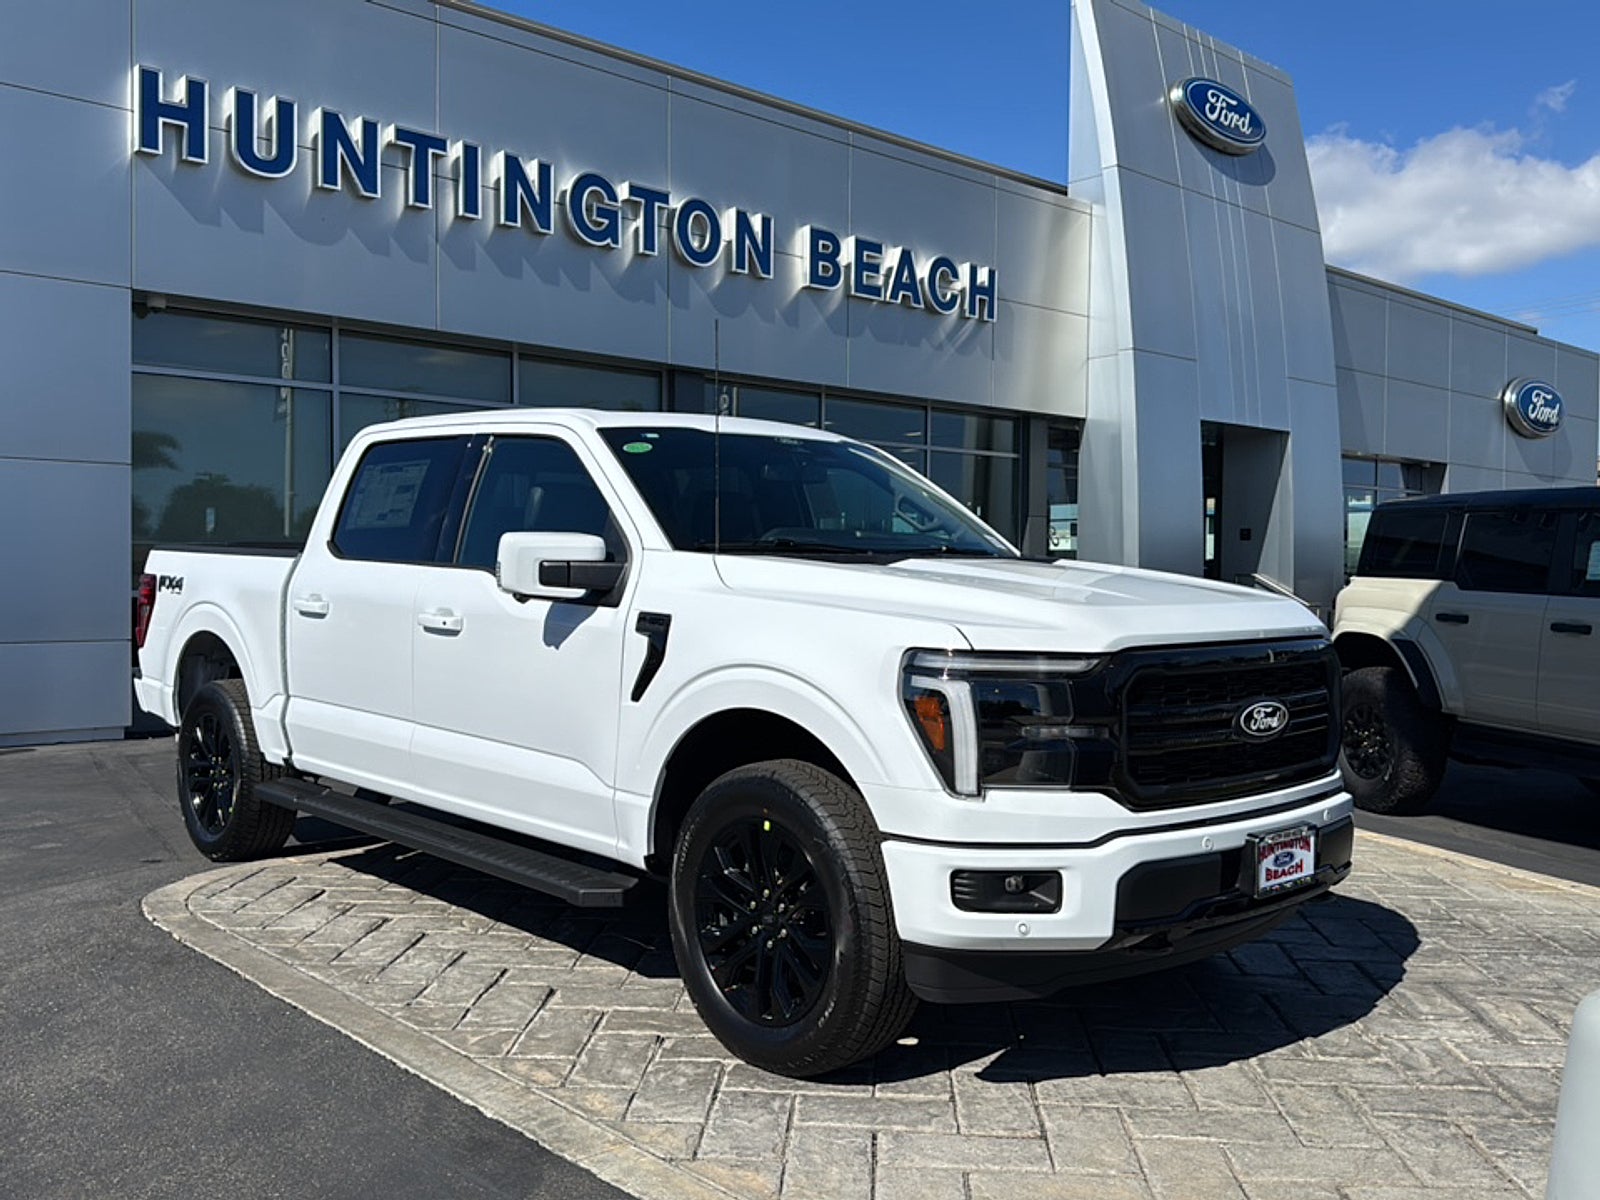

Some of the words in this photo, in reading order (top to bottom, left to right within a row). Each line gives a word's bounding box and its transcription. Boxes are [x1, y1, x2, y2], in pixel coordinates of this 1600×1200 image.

[1204, 88, 1253, 135] Ford
[134, 64, 775, 280] HUNTINGTON
[802, 225, 998, 322] BEACH
[1528, 389, 1561, 424] Ford
[158, 575, 185, 592] FX4
[1249, 706, 1281, 731] Ford
[1258, 834, 1311, 862] HUNTINGTON
[1265, 859, 1304, 882] BEACH
